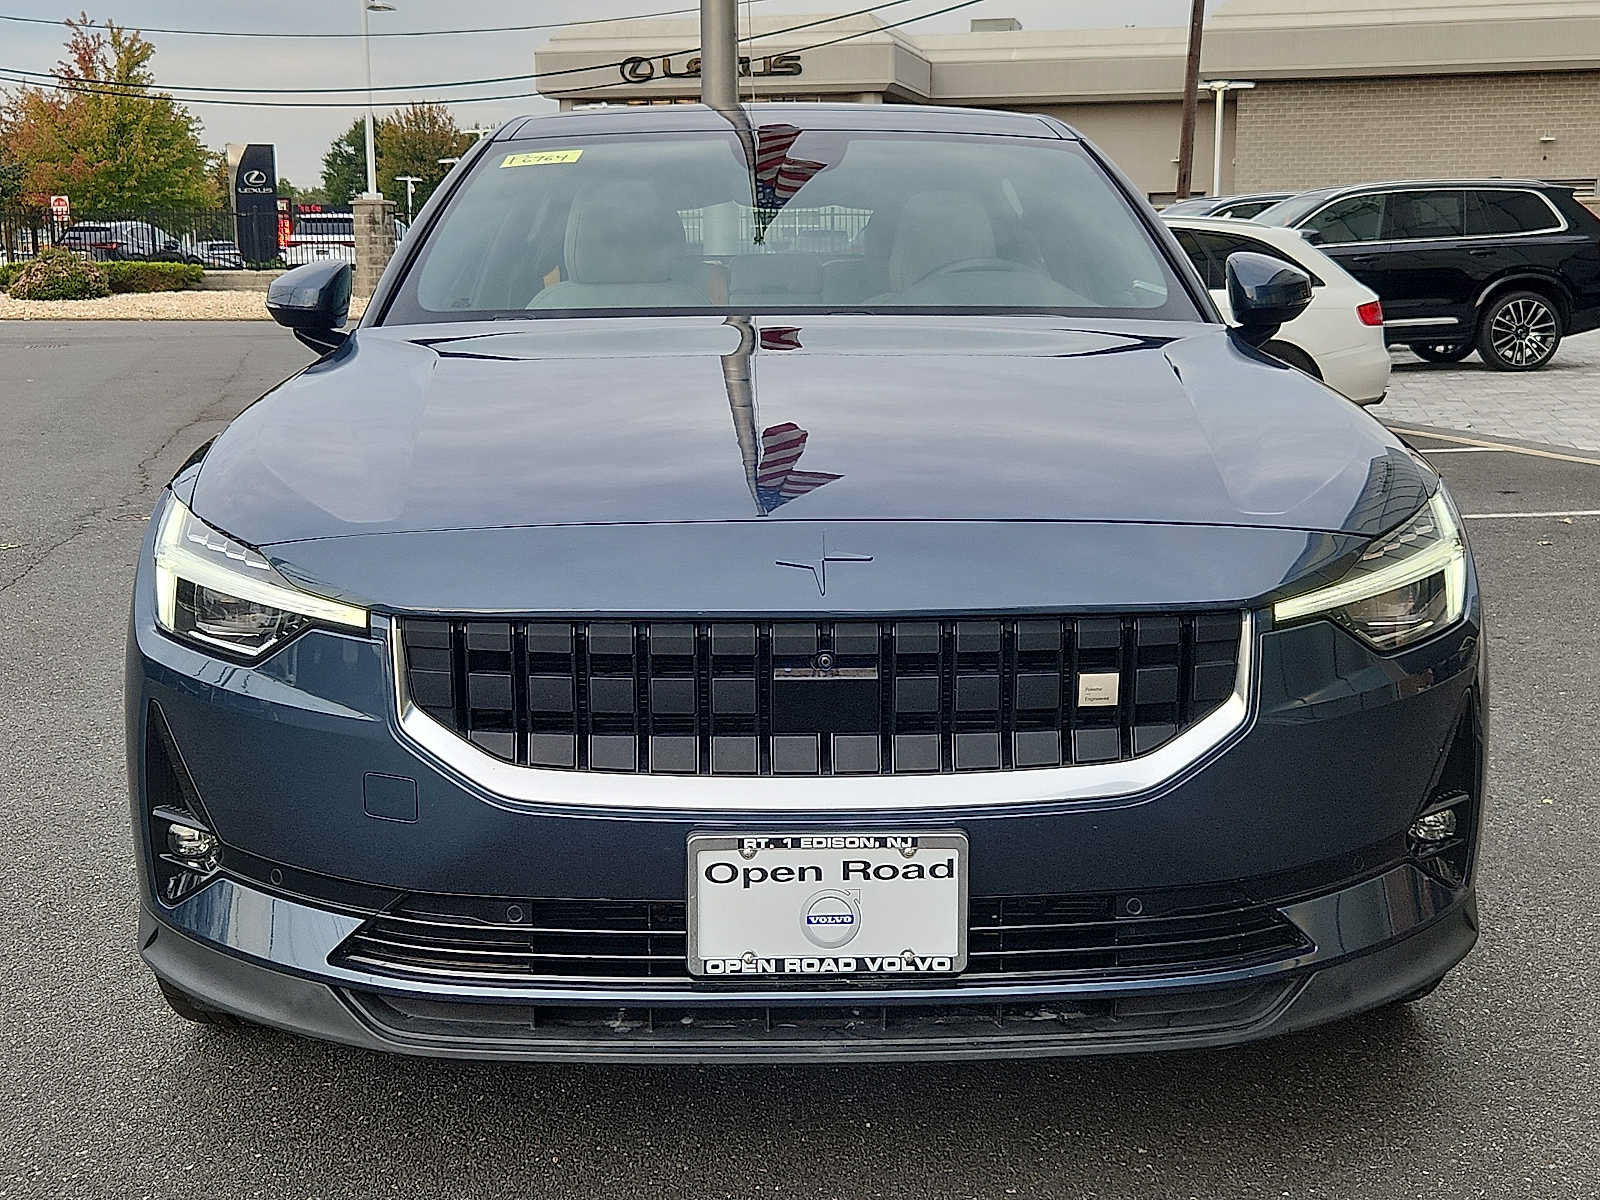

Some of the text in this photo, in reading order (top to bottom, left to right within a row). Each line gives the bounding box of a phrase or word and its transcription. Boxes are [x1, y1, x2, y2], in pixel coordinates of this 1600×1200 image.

[743, 837, 775, 850] RT.
[783, 837, 792, 849] 1
[886, 837, 913, 849] NJ
[704, 858, 955, 889] Open Road
[808, 915, 853, 924] VOLVO
[705, 956, 951, 974] OPEN ROAD VOLVO
